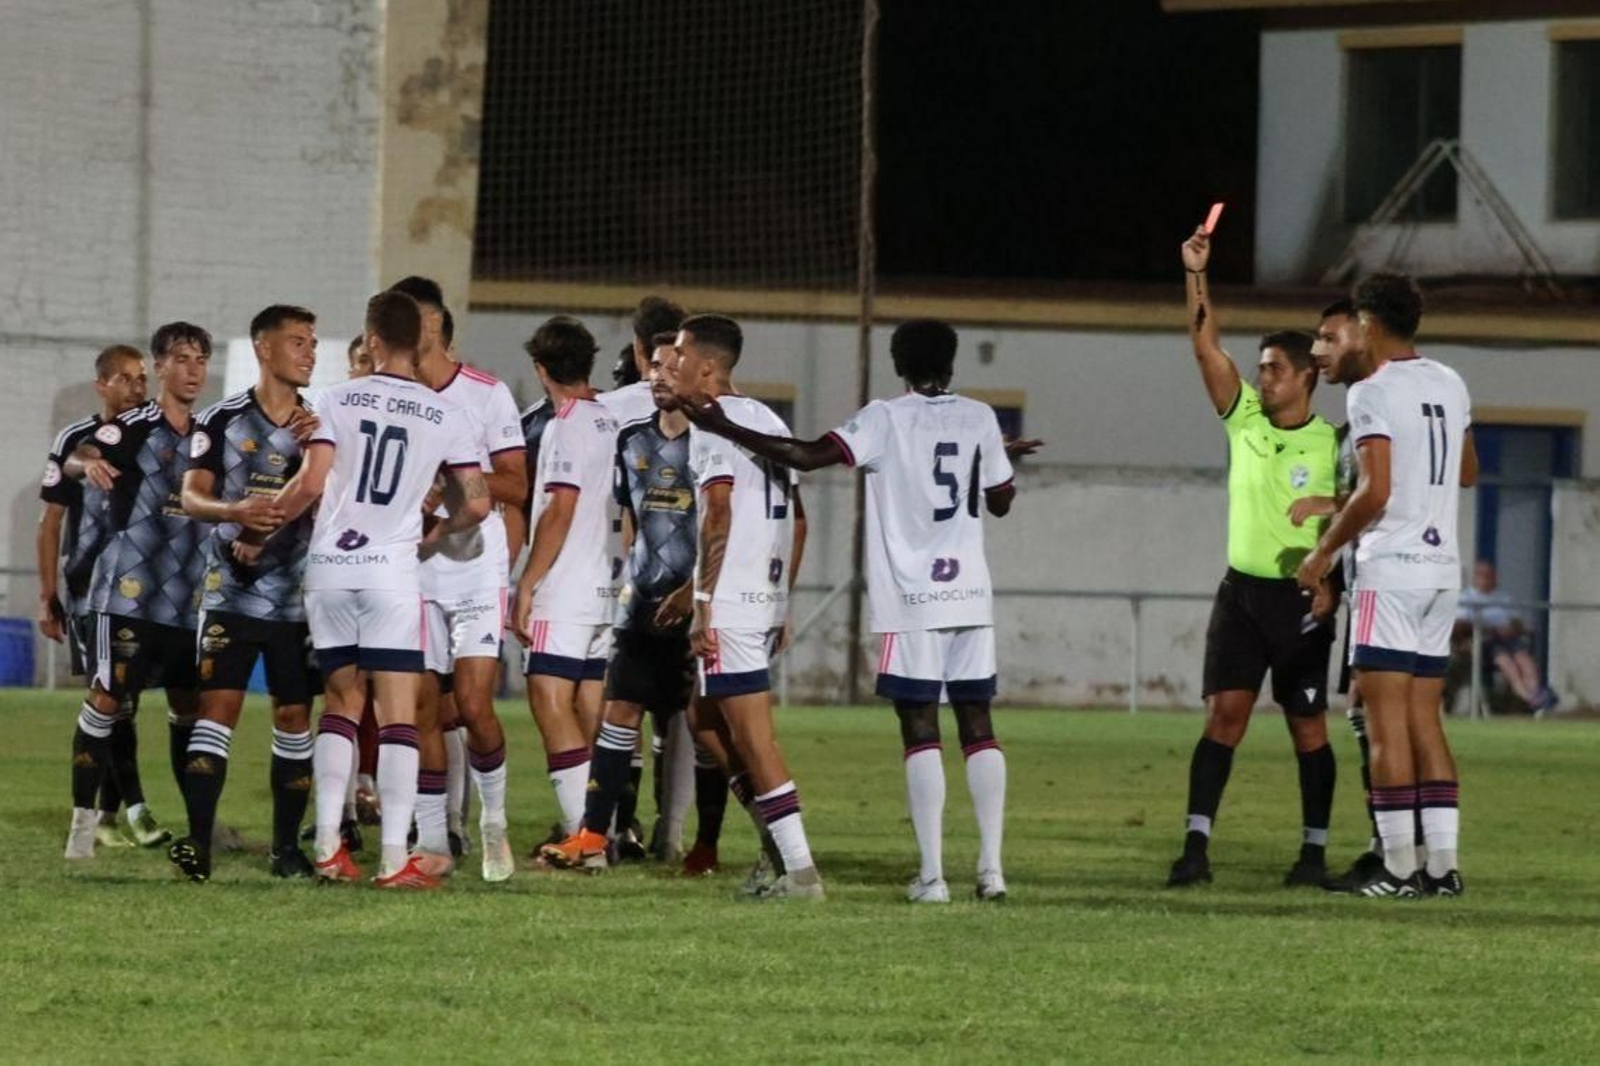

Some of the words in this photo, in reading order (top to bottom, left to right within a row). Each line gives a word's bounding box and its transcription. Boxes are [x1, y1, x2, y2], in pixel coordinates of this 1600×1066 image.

[339, 393, 382, 410] JOSE
[386, 397, 444, 425] CARLOS
[1421, 402, 1448, 486] 11
[355, 418, 408, 506] 10
